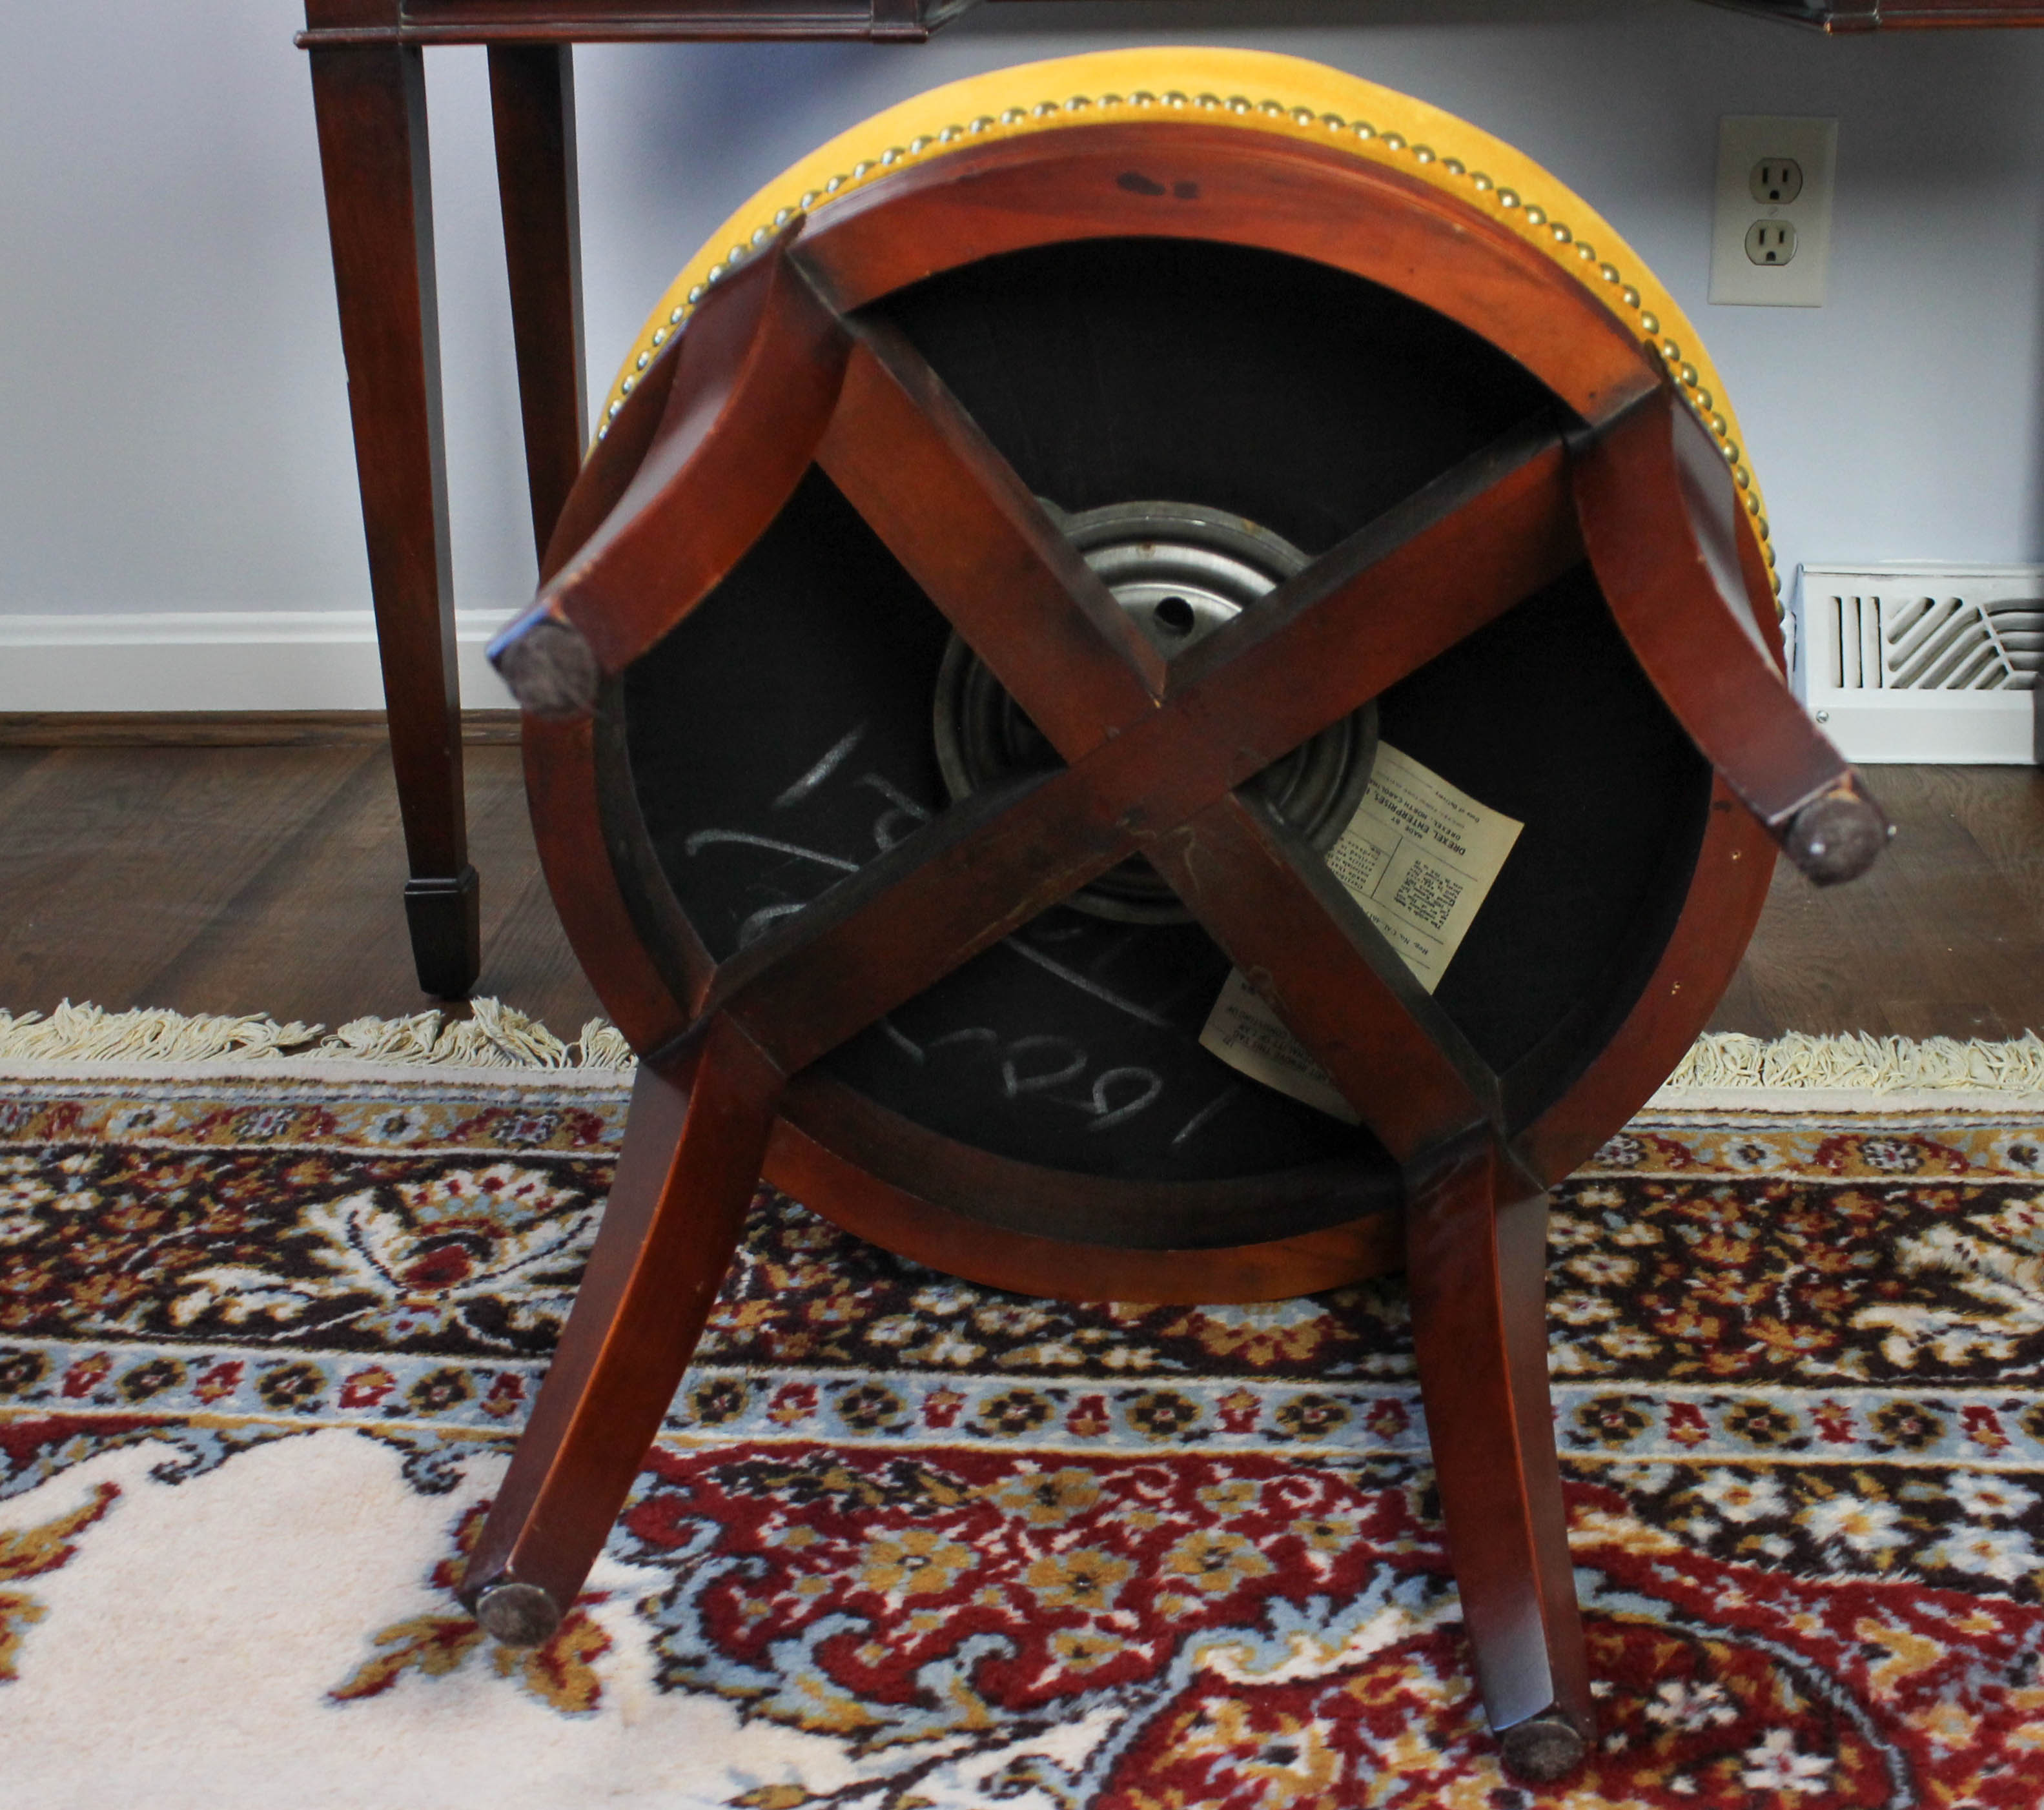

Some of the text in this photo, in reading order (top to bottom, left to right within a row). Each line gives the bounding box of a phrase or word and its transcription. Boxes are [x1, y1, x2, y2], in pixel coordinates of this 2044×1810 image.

[1402, 801, 1428, 820] NORTH
[1390, 815, 1424, 840] MADE BY
[1430, 829, 1466, 855] DREXEL
[1411, 941, 1429, 955] Reg.
